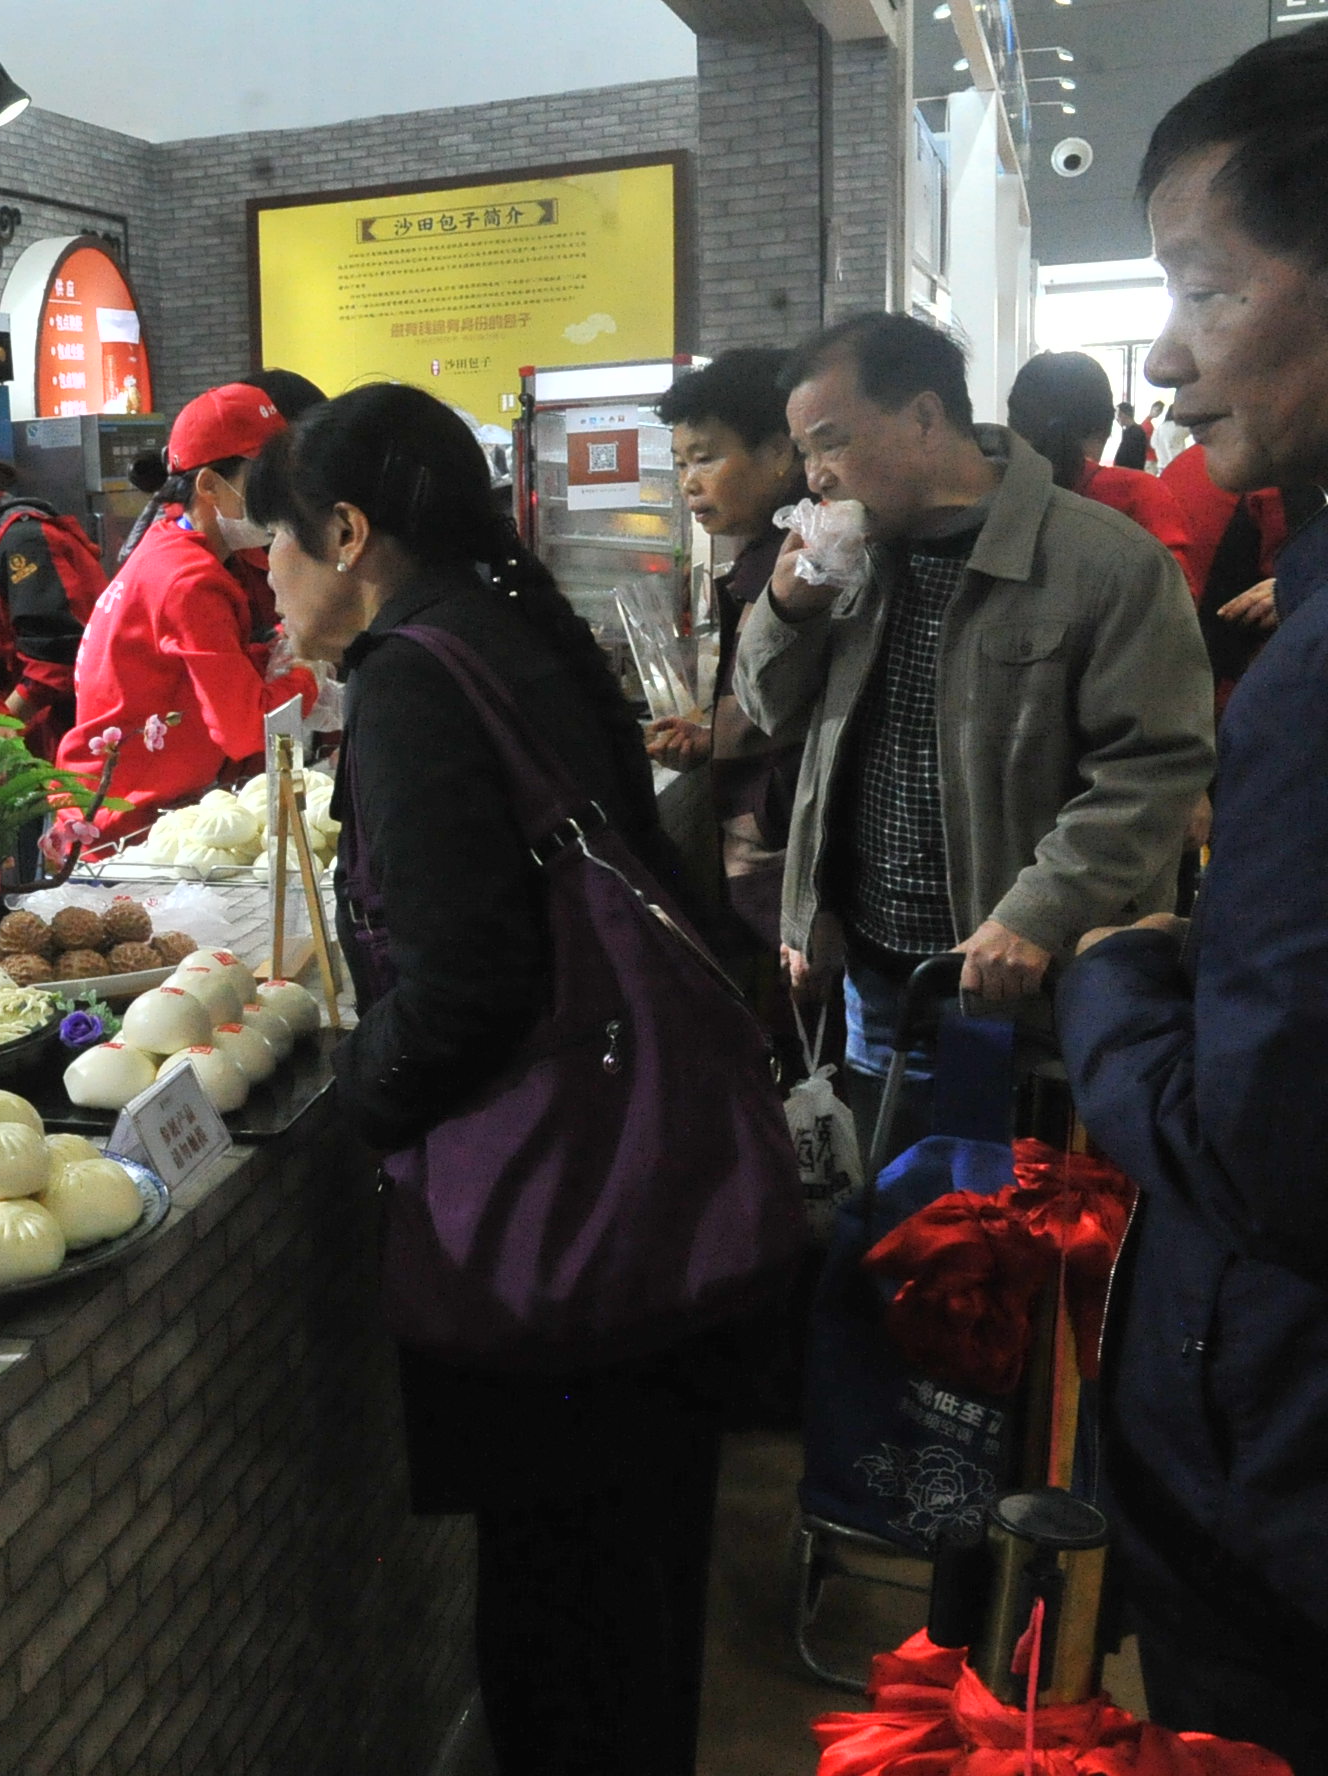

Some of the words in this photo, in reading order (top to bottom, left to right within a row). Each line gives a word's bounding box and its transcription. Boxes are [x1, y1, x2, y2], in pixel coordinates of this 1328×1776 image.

[393, 206, 525, 237] 沙田包子简介
